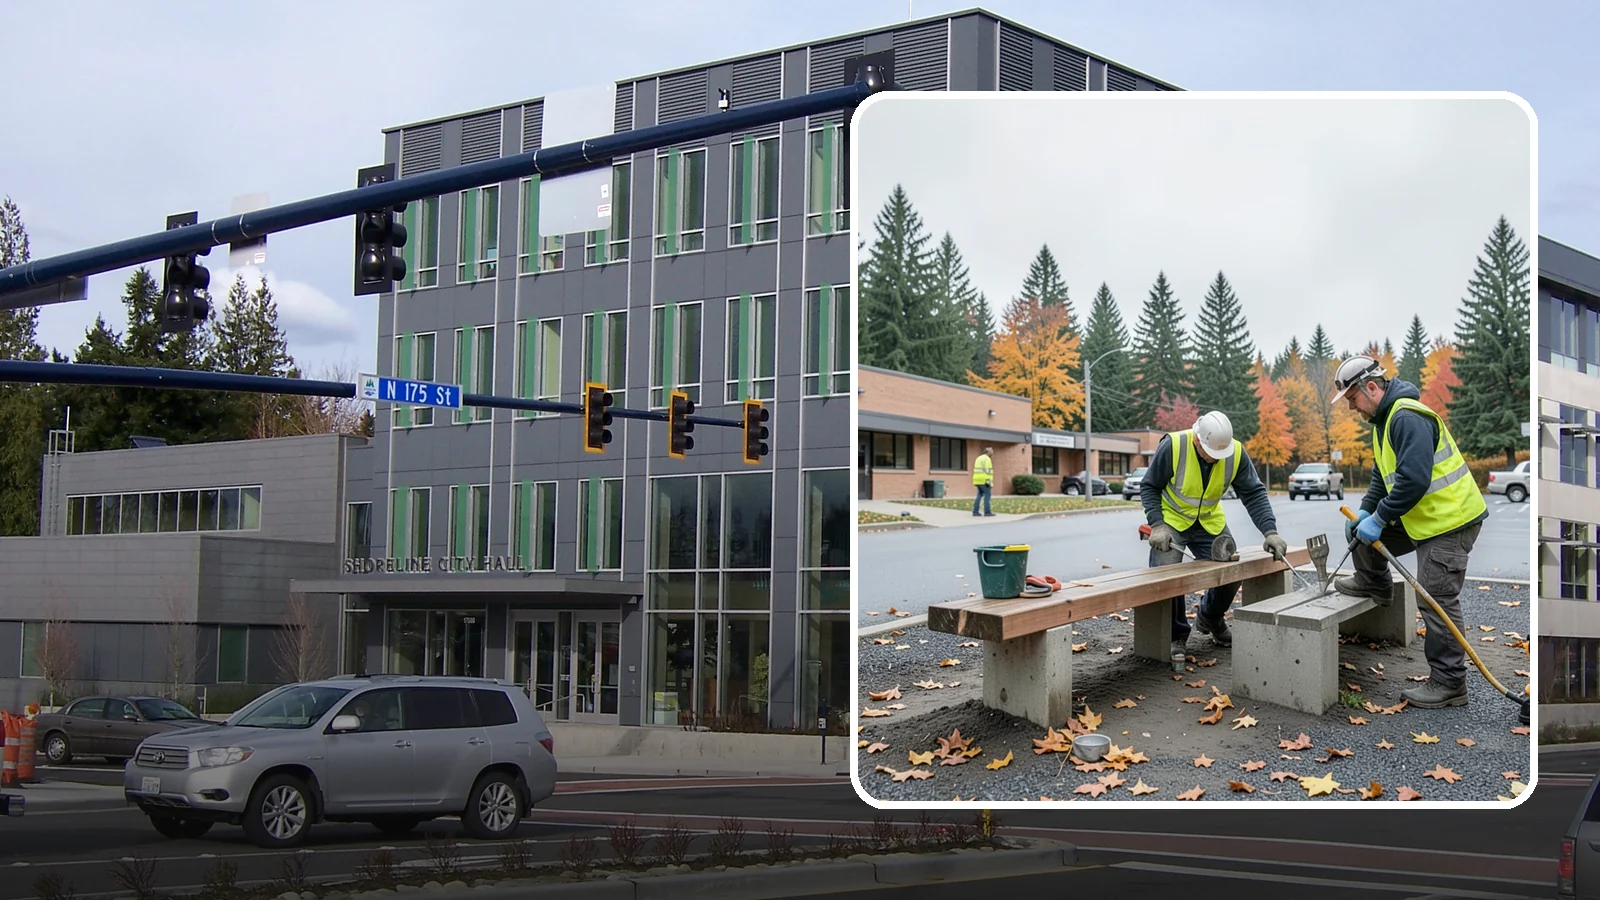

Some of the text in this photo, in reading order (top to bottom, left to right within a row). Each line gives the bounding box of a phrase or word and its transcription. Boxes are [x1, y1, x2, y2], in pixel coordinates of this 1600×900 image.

[387, 380, 451, 406] N 175 St
[344, 555, 526, 574] SHORELINE CITY HALL
